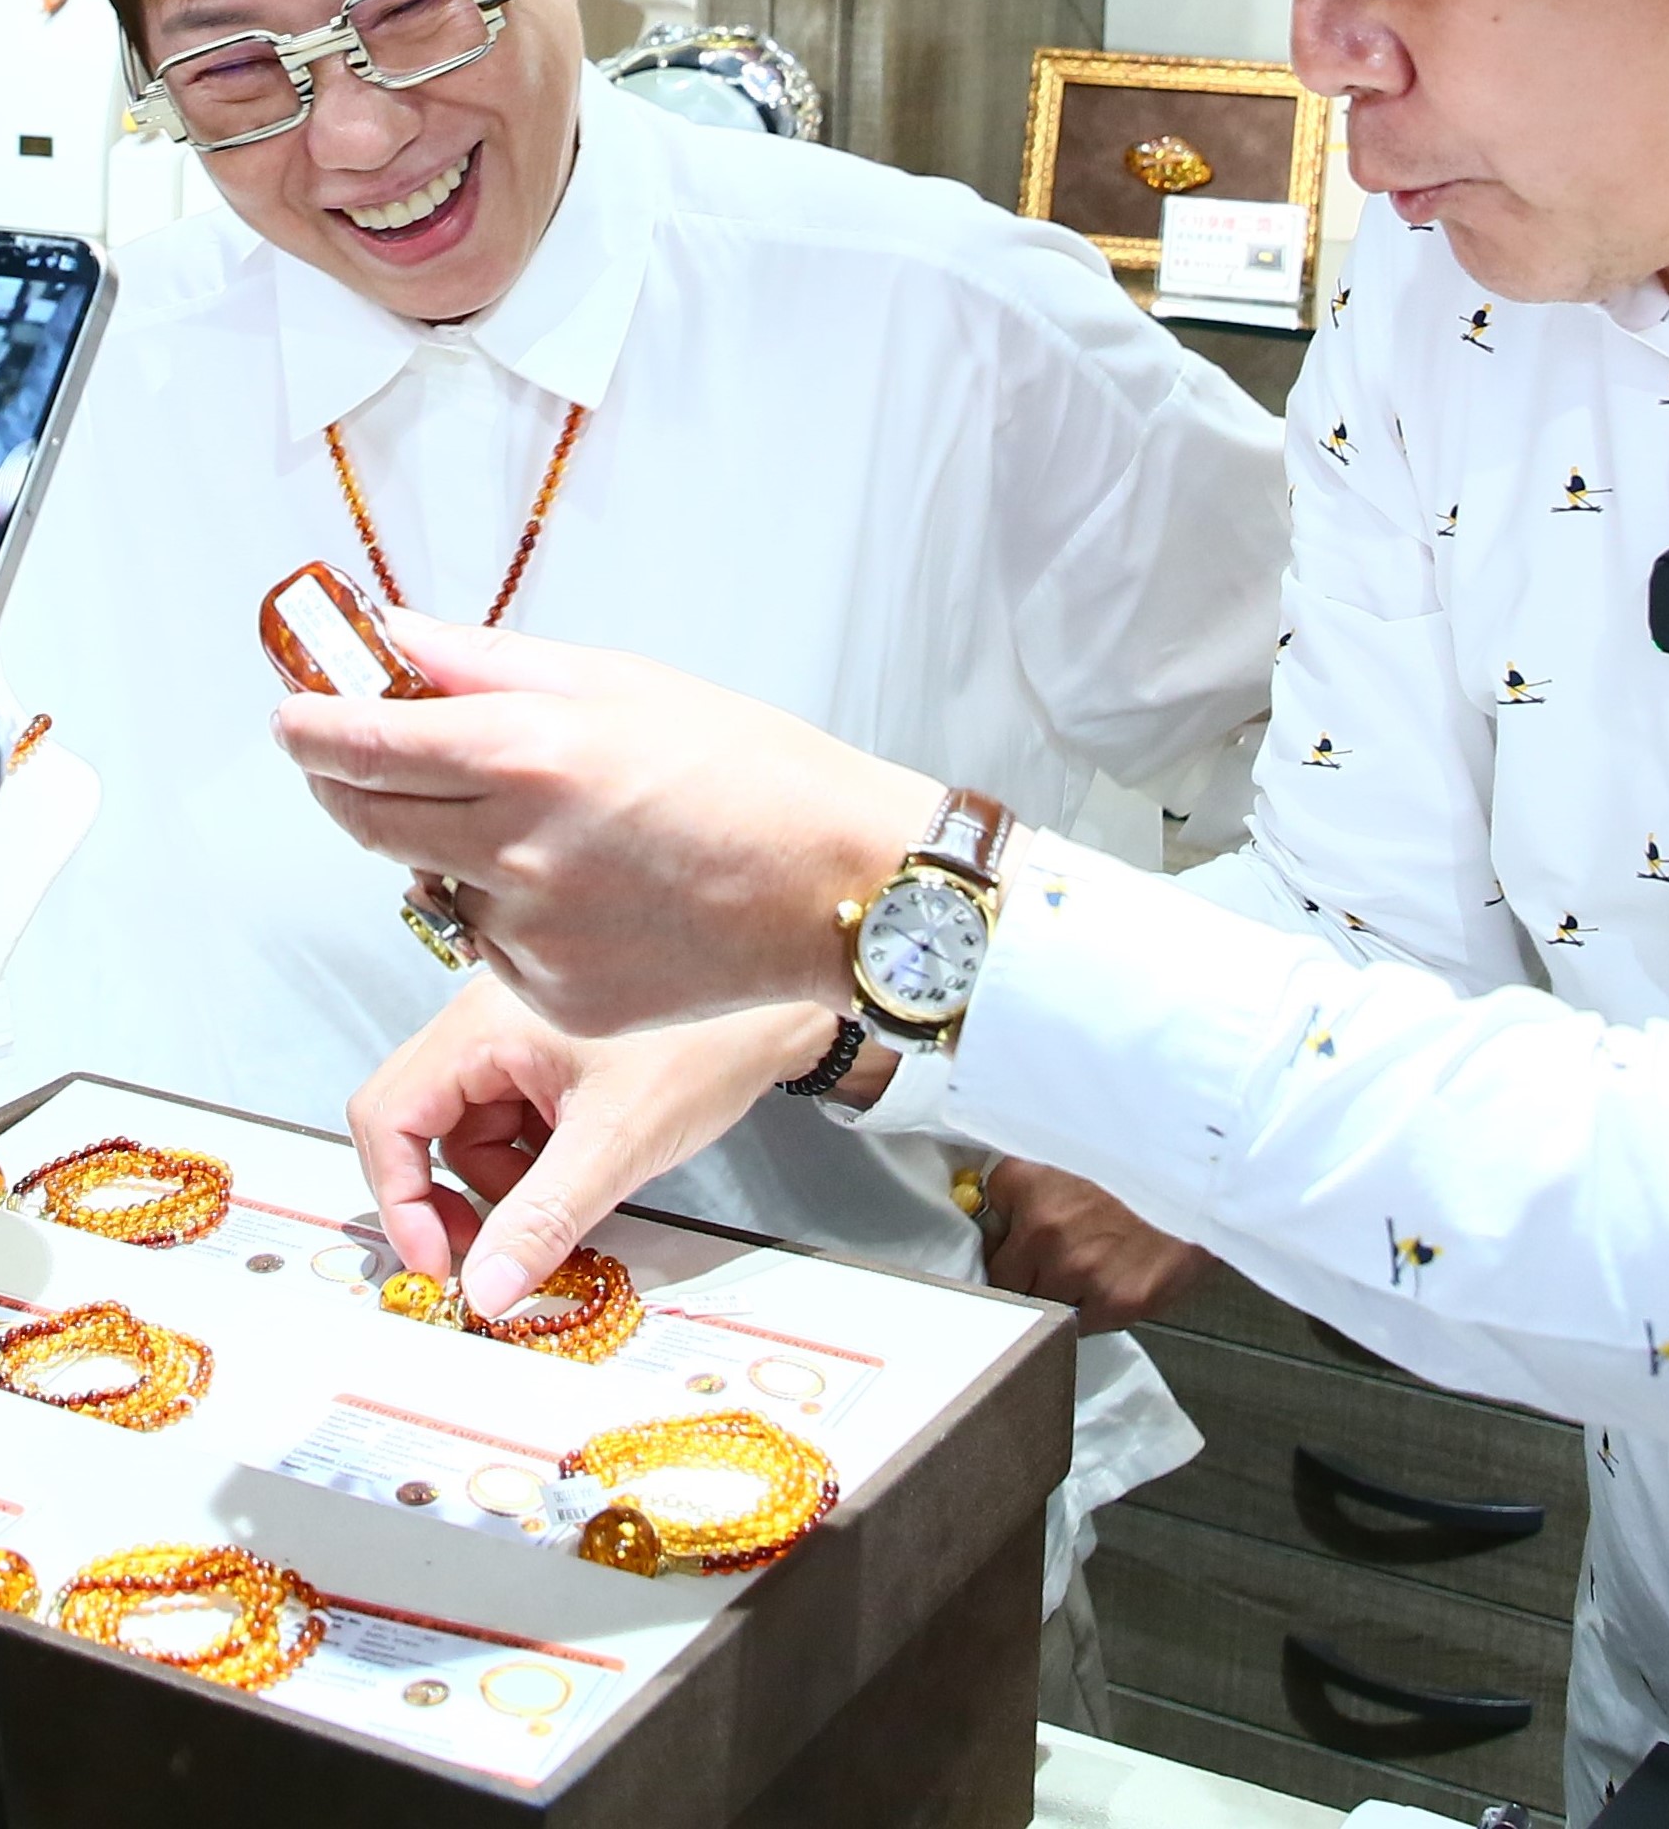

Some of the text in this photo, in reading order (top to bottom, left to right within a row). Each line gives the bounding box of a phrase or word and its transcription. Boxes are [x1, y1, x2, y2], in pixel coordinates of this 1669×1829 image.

[726, 1322, 769, 1341] AMBER
[772, 1332, 872, 1365] IDENTIFICATION
[347, 1398, 421, 1426] CERTIFICATE
[426, 1420, 445, 1432] OF
[448, 1427, 494, 1446] AMBER
